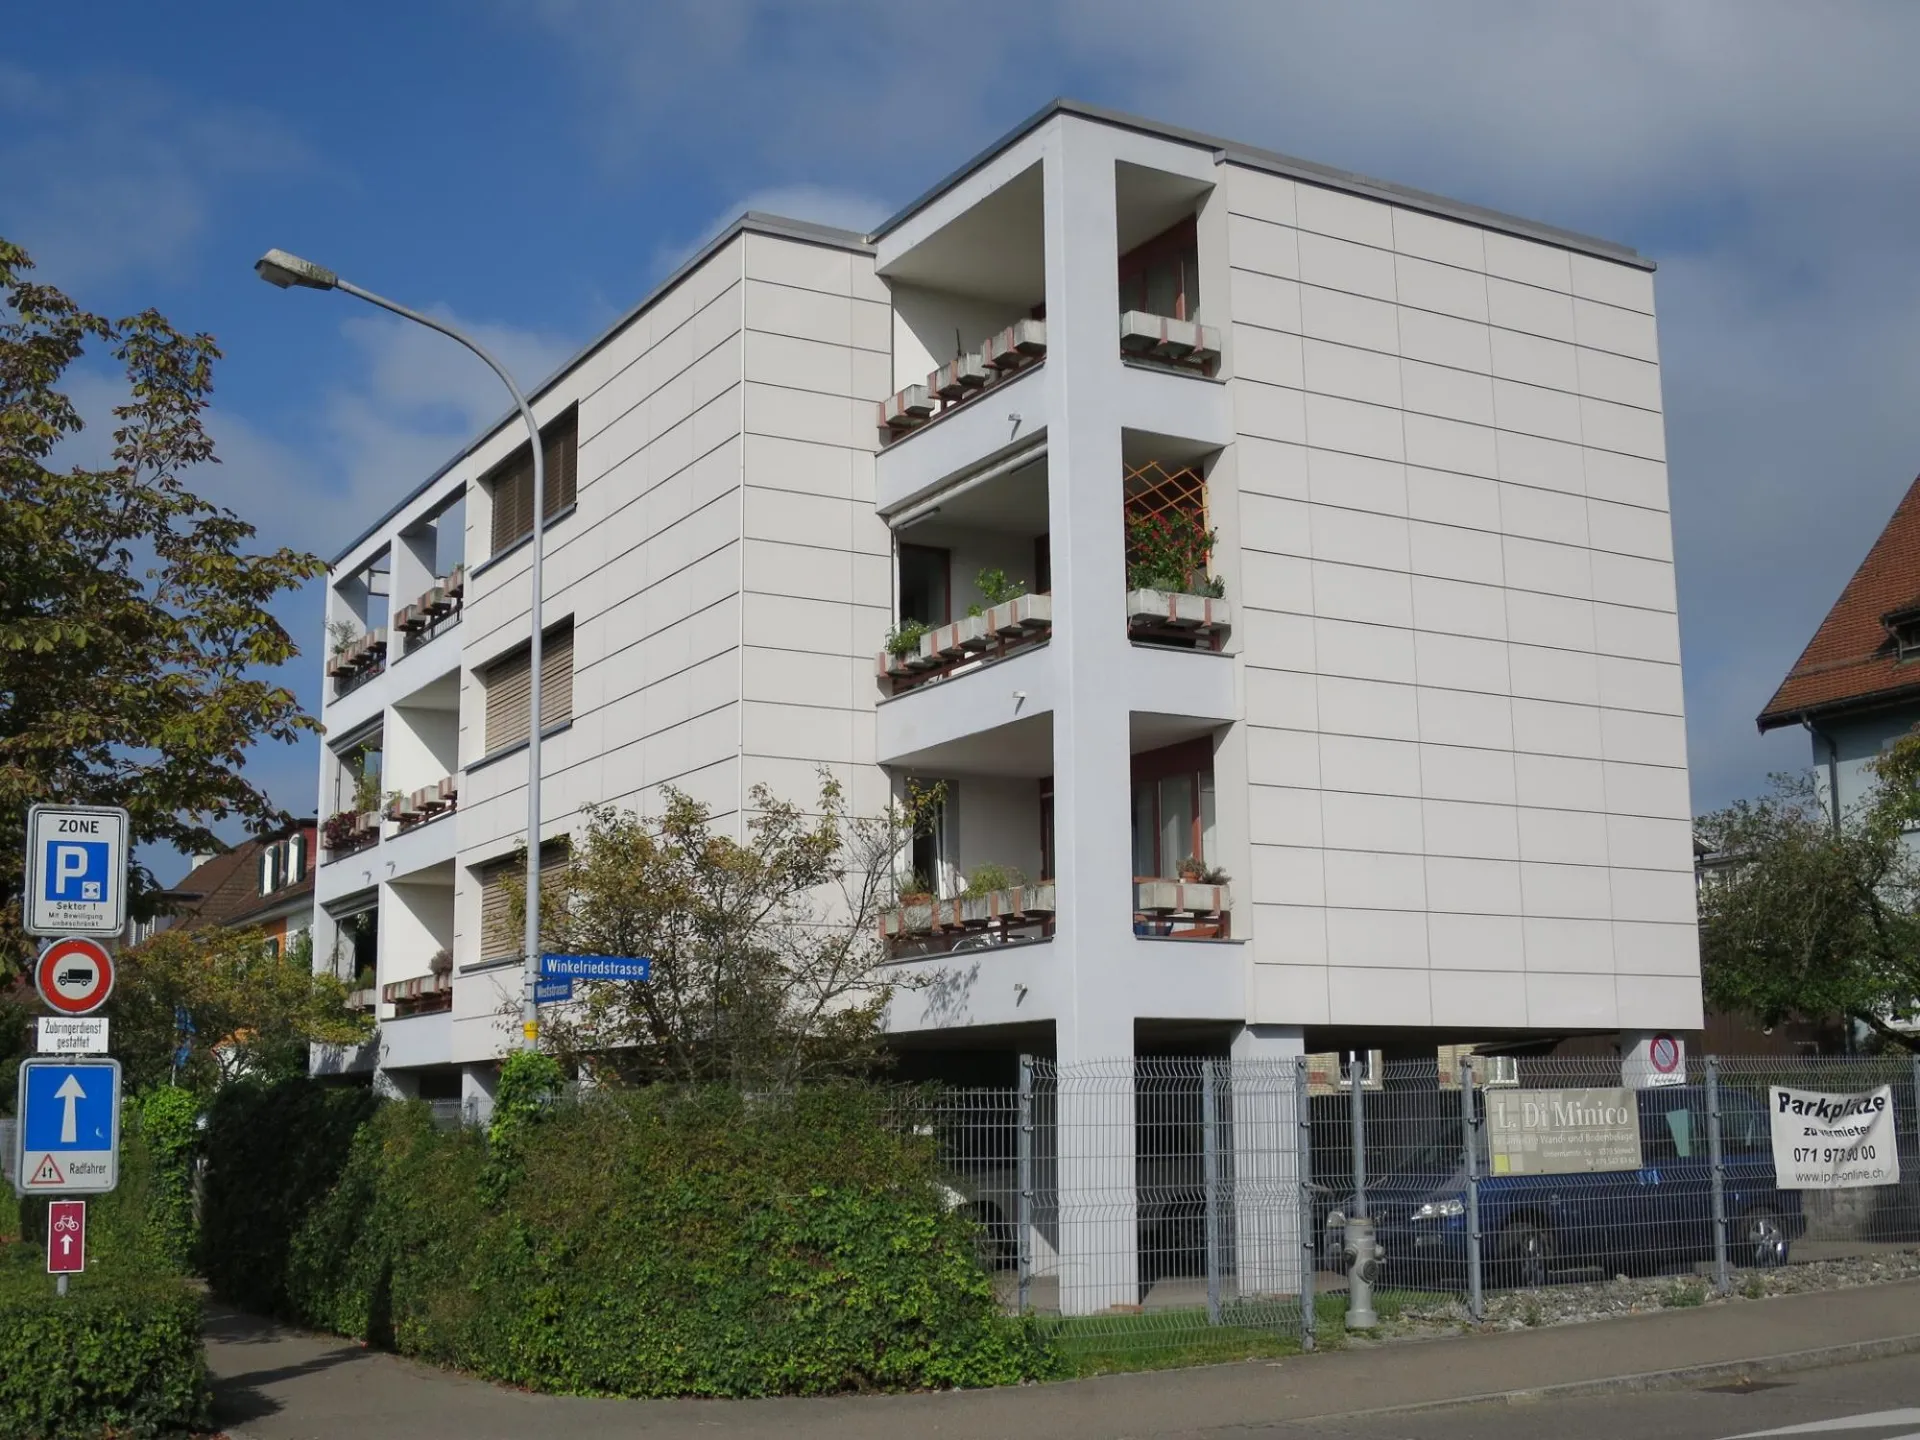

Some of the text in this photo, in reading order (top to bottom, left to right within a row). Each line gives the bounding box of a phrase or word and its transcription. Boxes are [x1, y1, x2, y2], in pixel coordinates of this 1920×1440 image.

[58, 819, 99, 834] ZONE
[55, 845, 88, 894] P
[56, 902, 86, 910] Sektor
[547, 959, 644, 976] Winkelriedstrasse
[1523, 1102, 1548, 1128] Di
[1554, 1101, 1628, 1127] Minico
[1803, 1127, 1817, 1136] zu
[1794, 1148, 1817, 1162] 071
[1861, 1145, 1876, 1160] 00
[69, 1162, 107, 1175] Radfahrer
